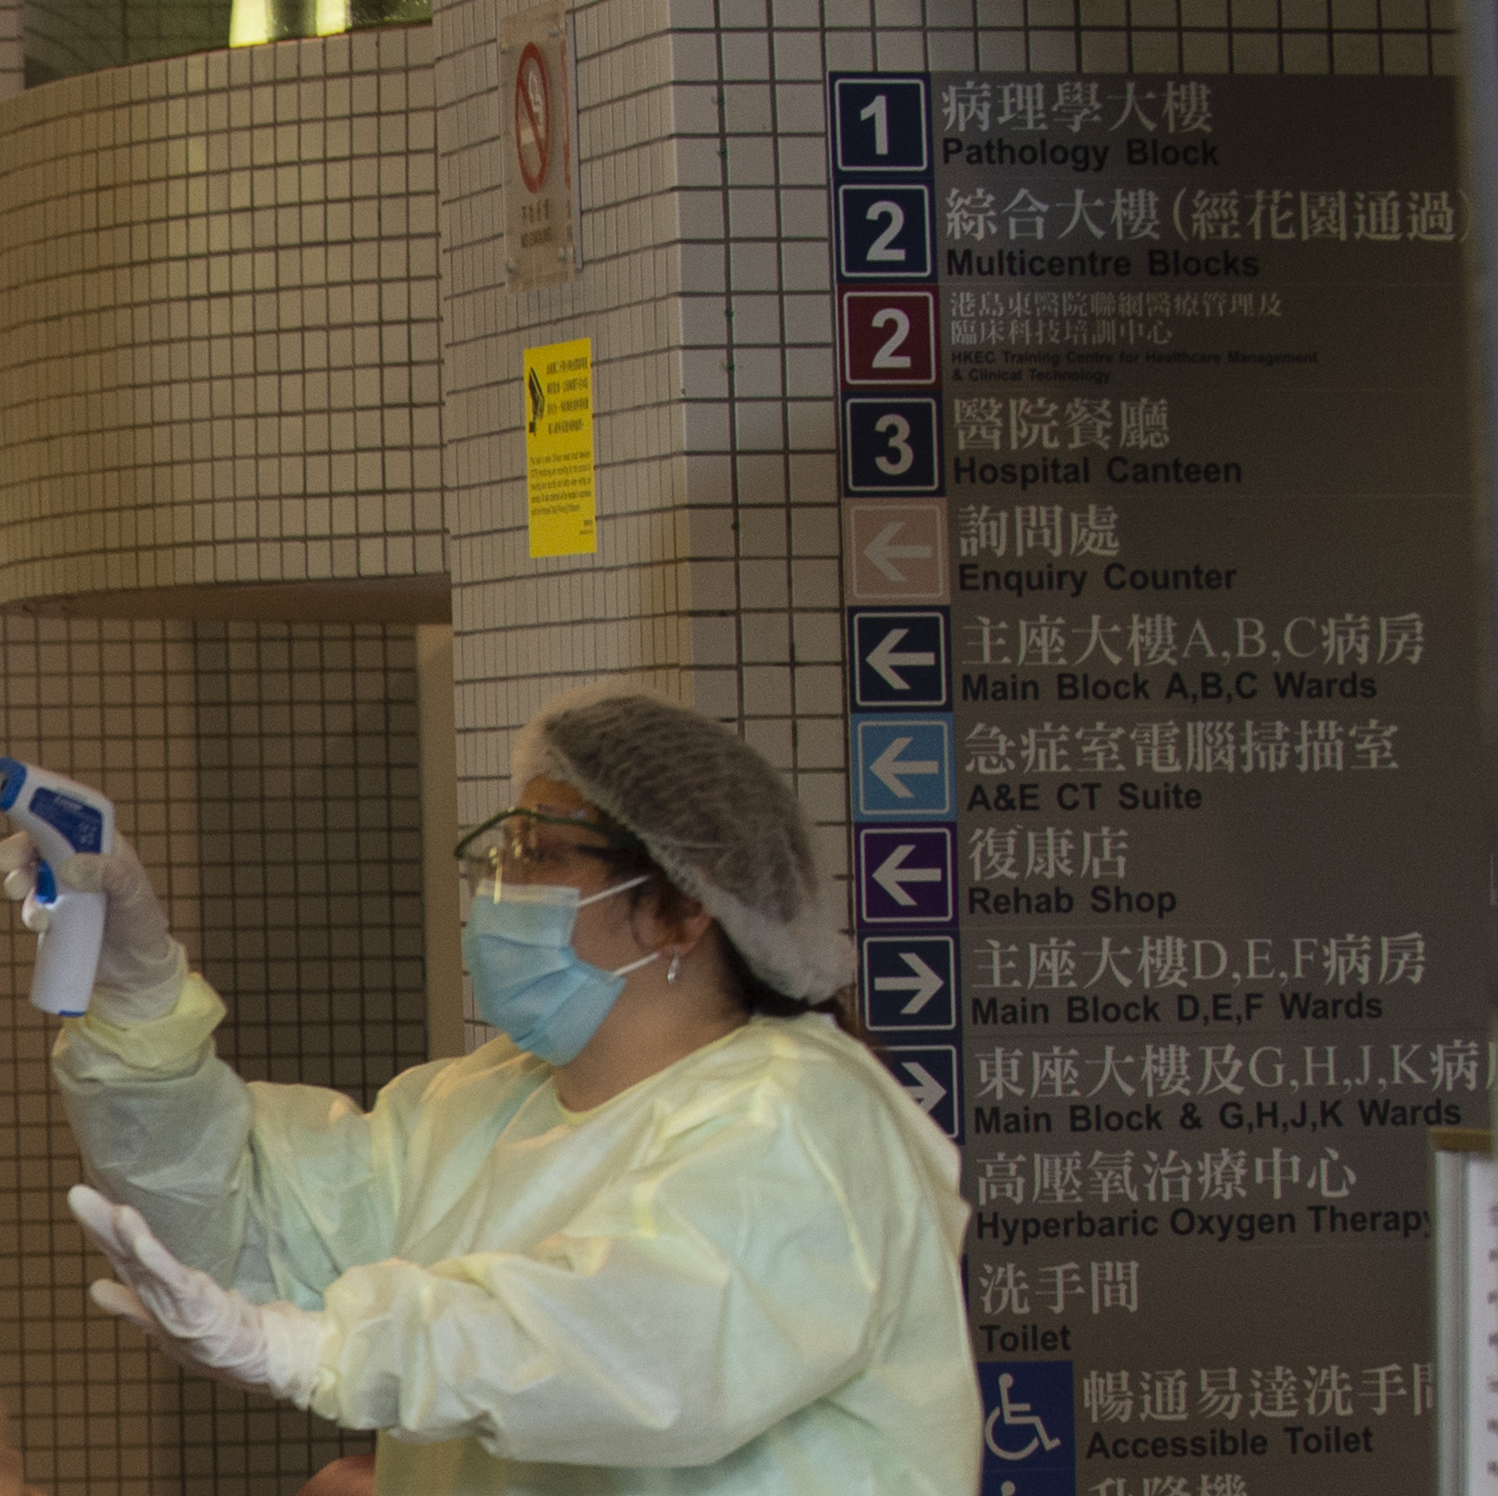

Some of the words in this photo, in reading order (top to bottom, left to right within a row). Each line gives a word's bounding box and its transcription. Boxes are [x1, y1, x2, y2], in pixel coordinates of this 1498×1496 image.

[860, 95, 889, 154] 1
[942, 80, 1212, 133] 病理學大樓
[943, 138, 1109, 171] Pathology
[1127, 138, 1219, 167] Block
[866, 201, 906, 261] 2
[946, 249, 1131, 277] Multicentre
[1149, 249, 1259, 277] Blocks
[871, 308, 911, 368] 2
[951, 319, 1173, 346] 臨床科技培訓中心
[952, 351, 996, 364] HKEC
[1004, 351, 1060, 366] Training
[1067, 351, 1113, 364] Centre
[1120, 351, 1139, 364] for
[1146, 351, 1222, 364] Healthcare
[1228, 351, 1318, 367] Management
[953, 369, 963, 381] &
[969, 368, 1021, 381] Clinical
[1030, 369, 1110, 384] Technology
[954, 396, 1170, 451] 醫院餐廳
[874, 415, 914, 475] 3
[954, 457, 1090, 491] Hospital
[1107, 457, 1242, 484] Canteen
[959, 504, 1120, 558] 詢問處
[959, 565, 1087, 598] Enquiry
[1104, 563, 1237, 591] Counter
[961, 612, 1425, 667] 主座大樓A,B,C病房
[962, 673, 1039, 702] Main
[1058, 672, 1150, 701] Block
[1165, 670, 1259, 706] A,B,C
[1273, 670, 1378, 700] Wards
[965, 718, 1400, 775] 急症室電腦掃描室
[967, 782, 1041, 812] A&E
[1056, 782, 1102, 811] CT
[1119, 782, 1203, 811] Suite
[967, 825, 1129, 880] 復康店
[968, 886, 1073, 915] Rehab
[1090, 886, 1177, 921] Shop
[971, 931, 1427, 991] 主座大樓D,E,F病房
[971, 997, 1049, 1026] Main
[1068, 996, 1160, 1024] Block
[1177, 994, 1264, 1029] D,E,F
[1279, 993, 1384, 1021] Wards
[974, 1104, 1052, 1134] Main
[1070, 1103, 1163, 1132] Block
[1180, 1102, 1203, 1130] &
[1219, 1100, 1344, 1137] G,H,J,K
[1358, 1098, 1463, 1127] Wards
[975, 1147, 1357, 1207] 高壓氧治療中心
[977, 1208, 1158, 1246] Hyperbaric
[1170, 1206, 1297, 1242] Oxygen
[977, 1260, 1140, 1315] 洗手間
[980, 1324, 1072, 1352] Toilet
[1085, 1427, 1269, 1460] Accessible
[1283, 1425, 1374, 1454] Toilet
